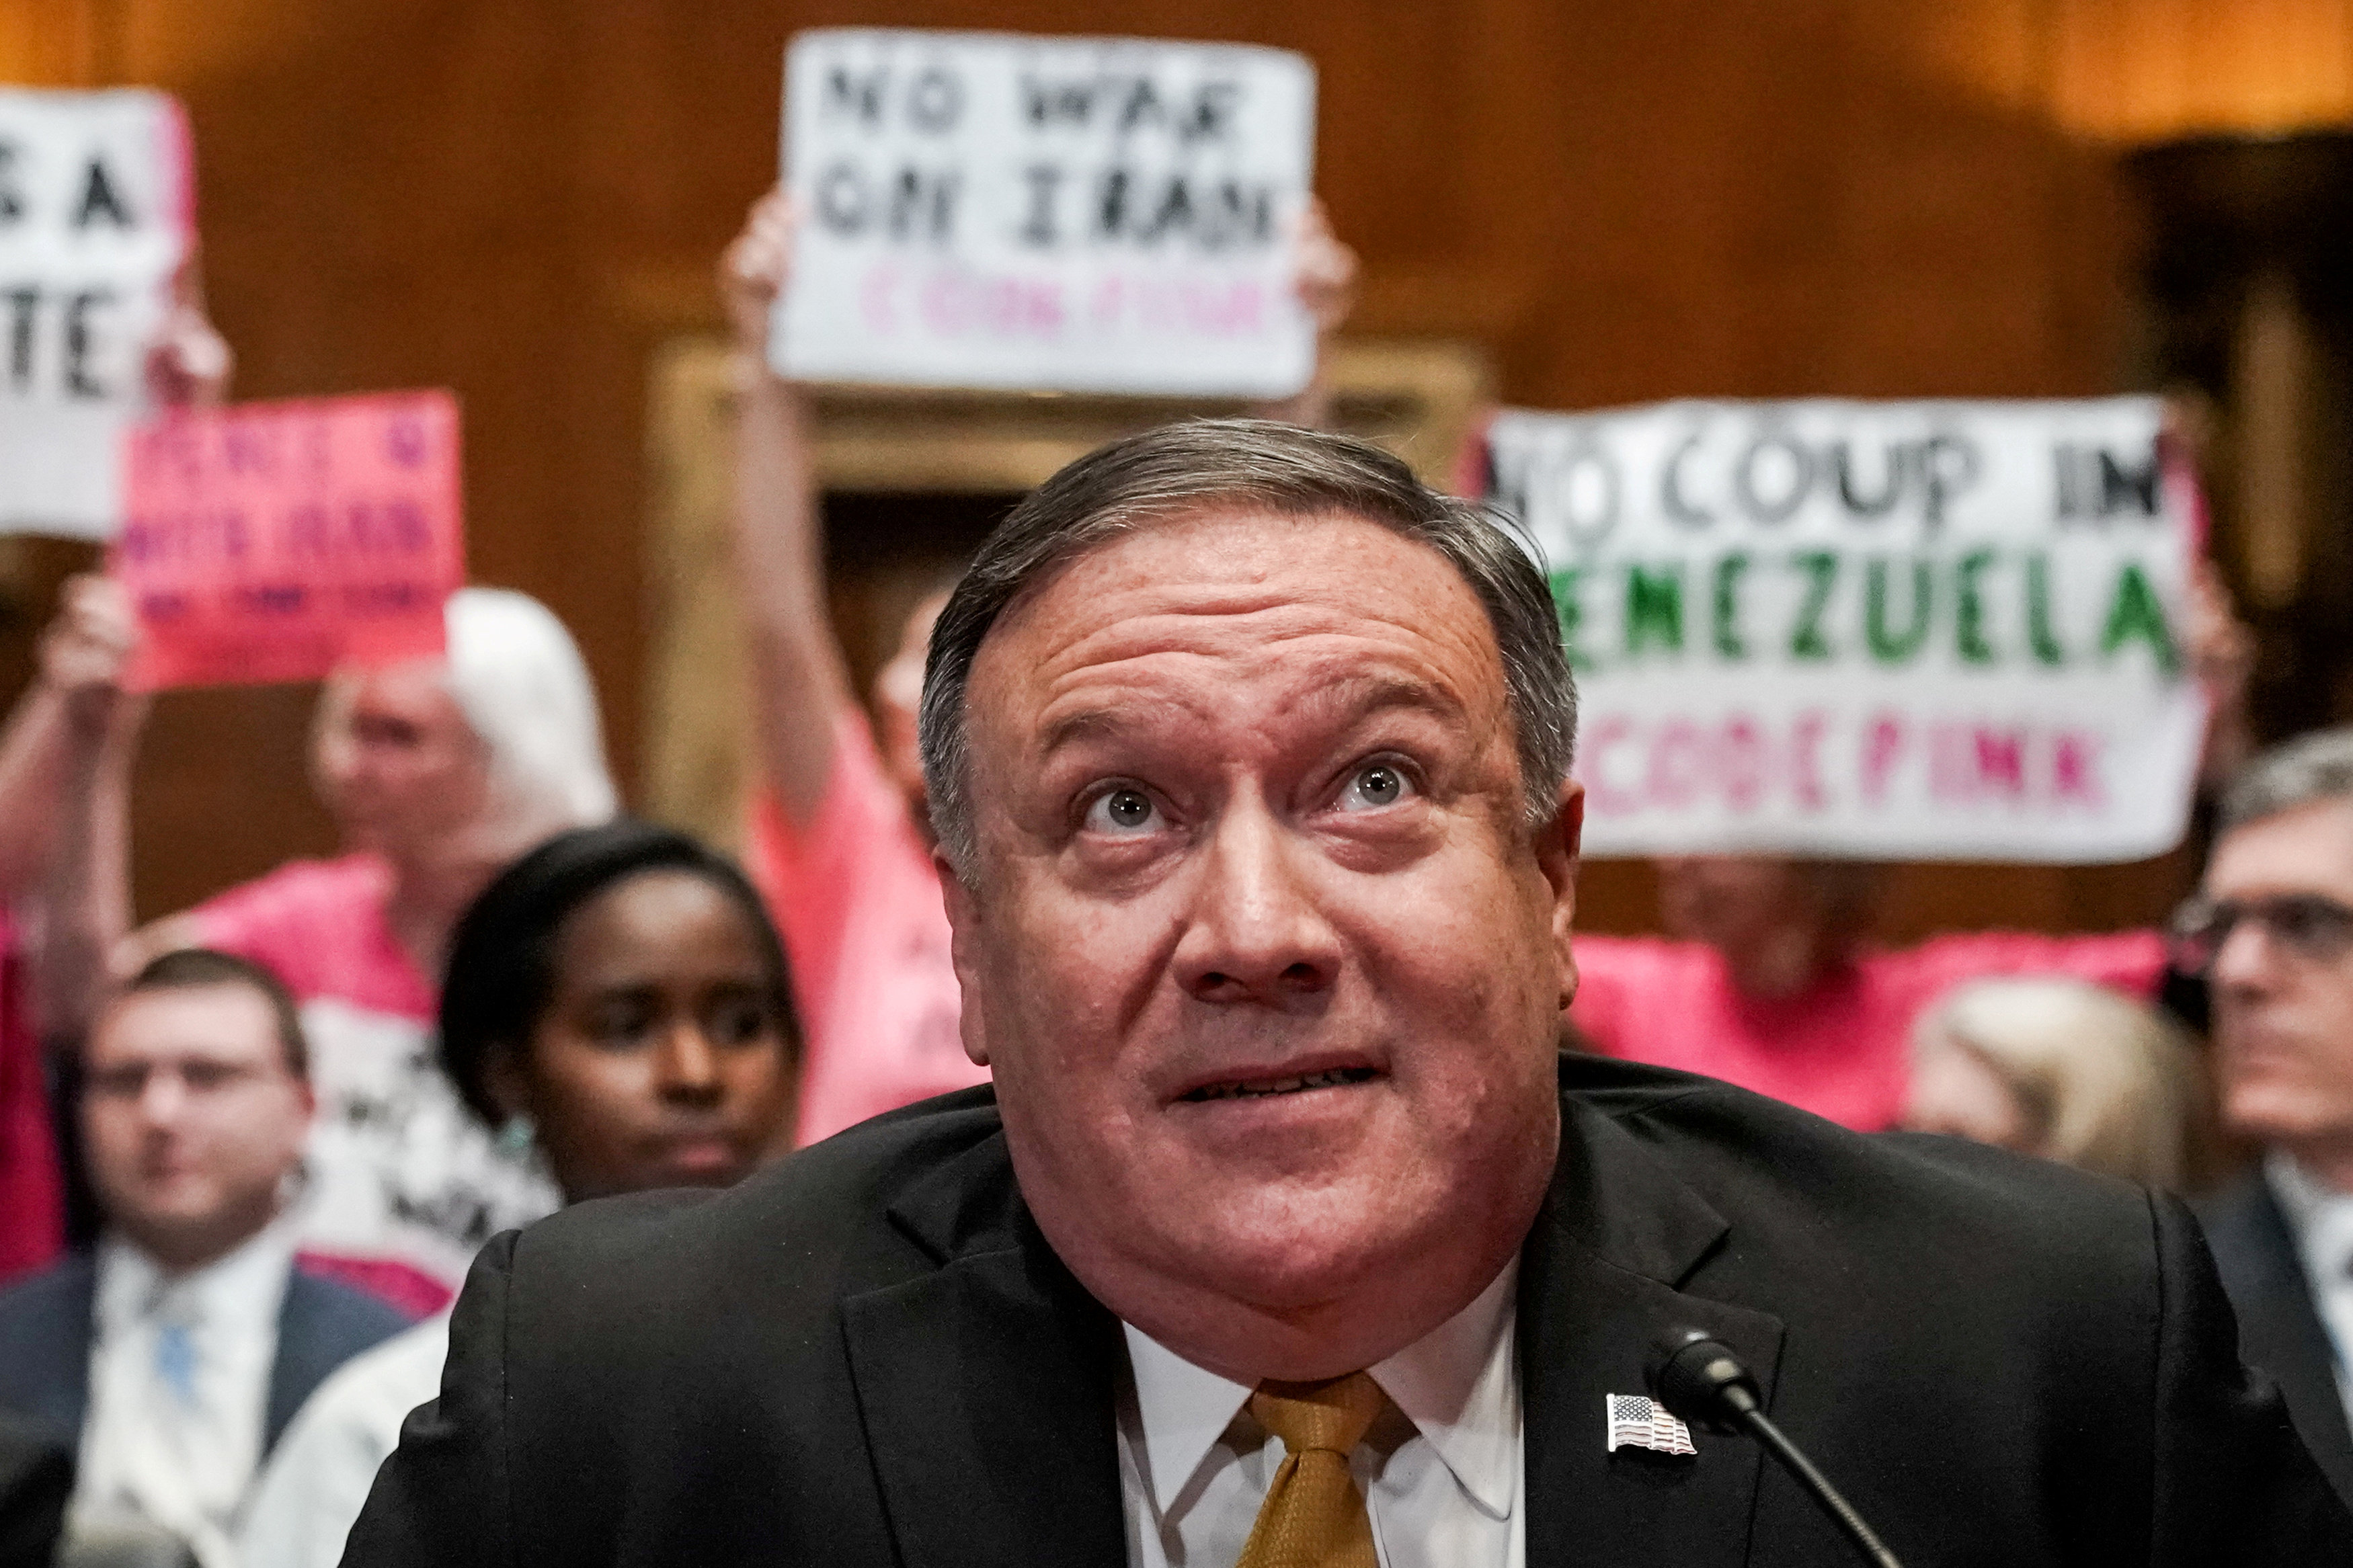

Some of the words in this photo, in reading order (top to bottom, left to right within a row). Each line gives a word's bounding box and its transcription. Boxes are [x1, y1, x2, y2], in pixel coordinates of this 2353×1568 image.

[820, 63, 965, 134] NO
[1018, 70, 1248, 138] WAR
[71, 159, 136, 233] A
[815, 159, 961, 245] ON
[1022, 165, 1275, 249] IRAN
[1663, 430, 1981, 538] COUP
[2050, 437, 2167, 522] IN
[1551, 547, 2180, 677] ENEZUELA
